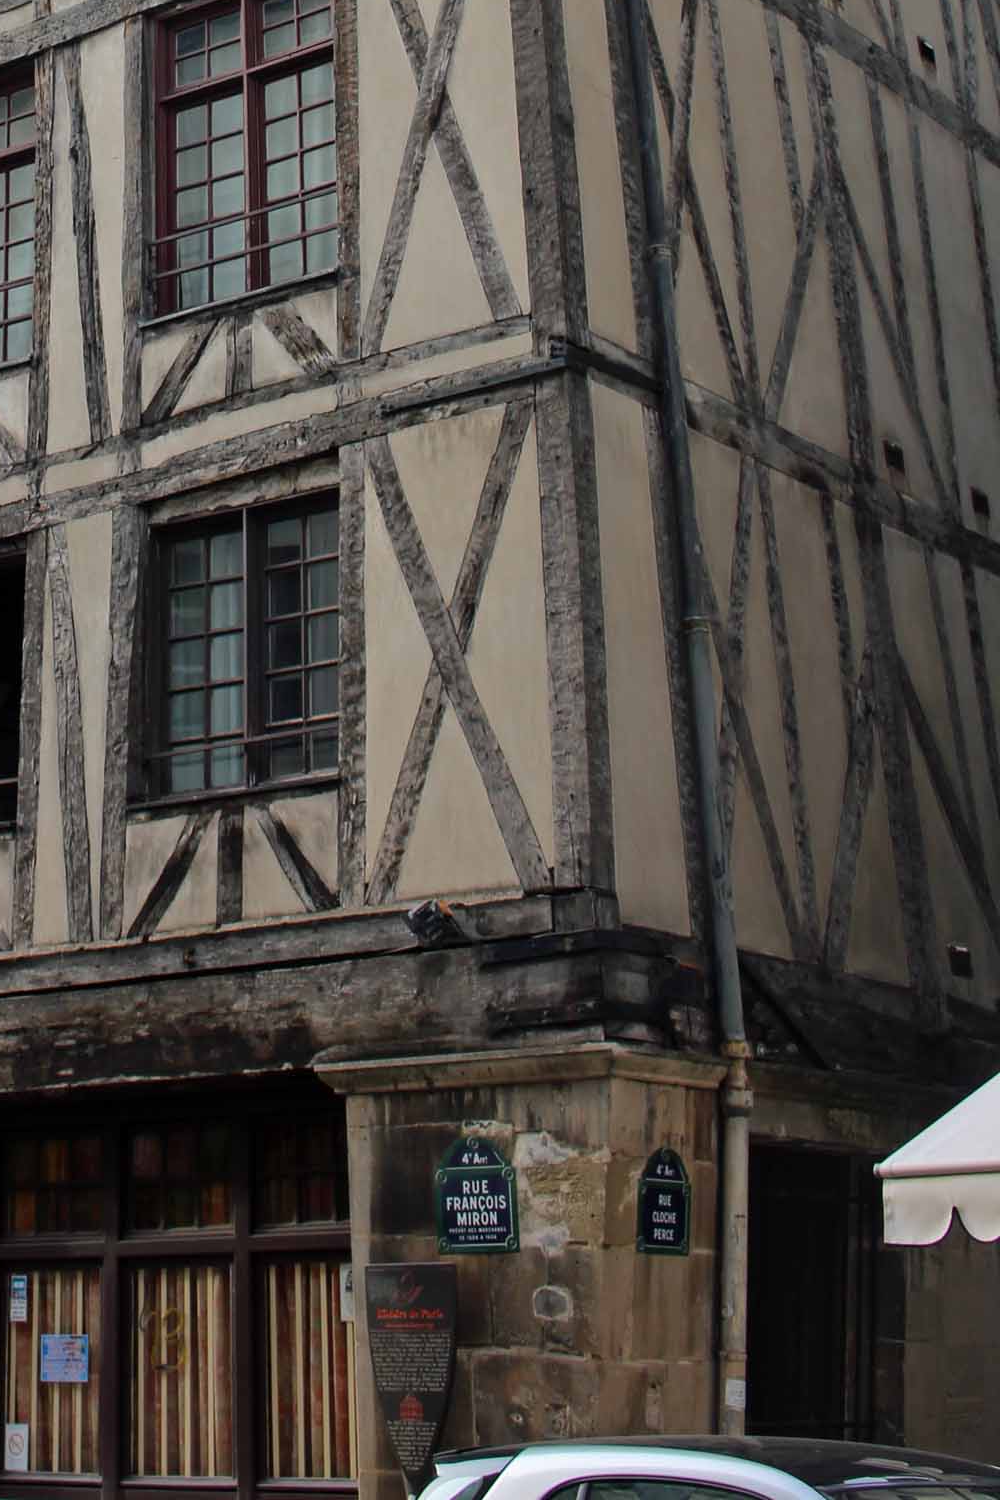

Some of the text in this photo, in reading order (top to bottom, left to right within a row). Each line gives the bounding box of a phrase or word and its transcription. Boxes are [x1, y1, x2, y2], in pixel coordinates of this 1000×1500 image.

[462, 1180, 489, 1195] RUE
[446, 1195, 507, 1211] FRANÇOIS
[658, 1193, 672, 1207] RUE
[456, 1211, 498, 1226] MIRON
[652, 1211, 677, 1224] CLOCHE
[653, 1227, 675, 1241] PERCE
